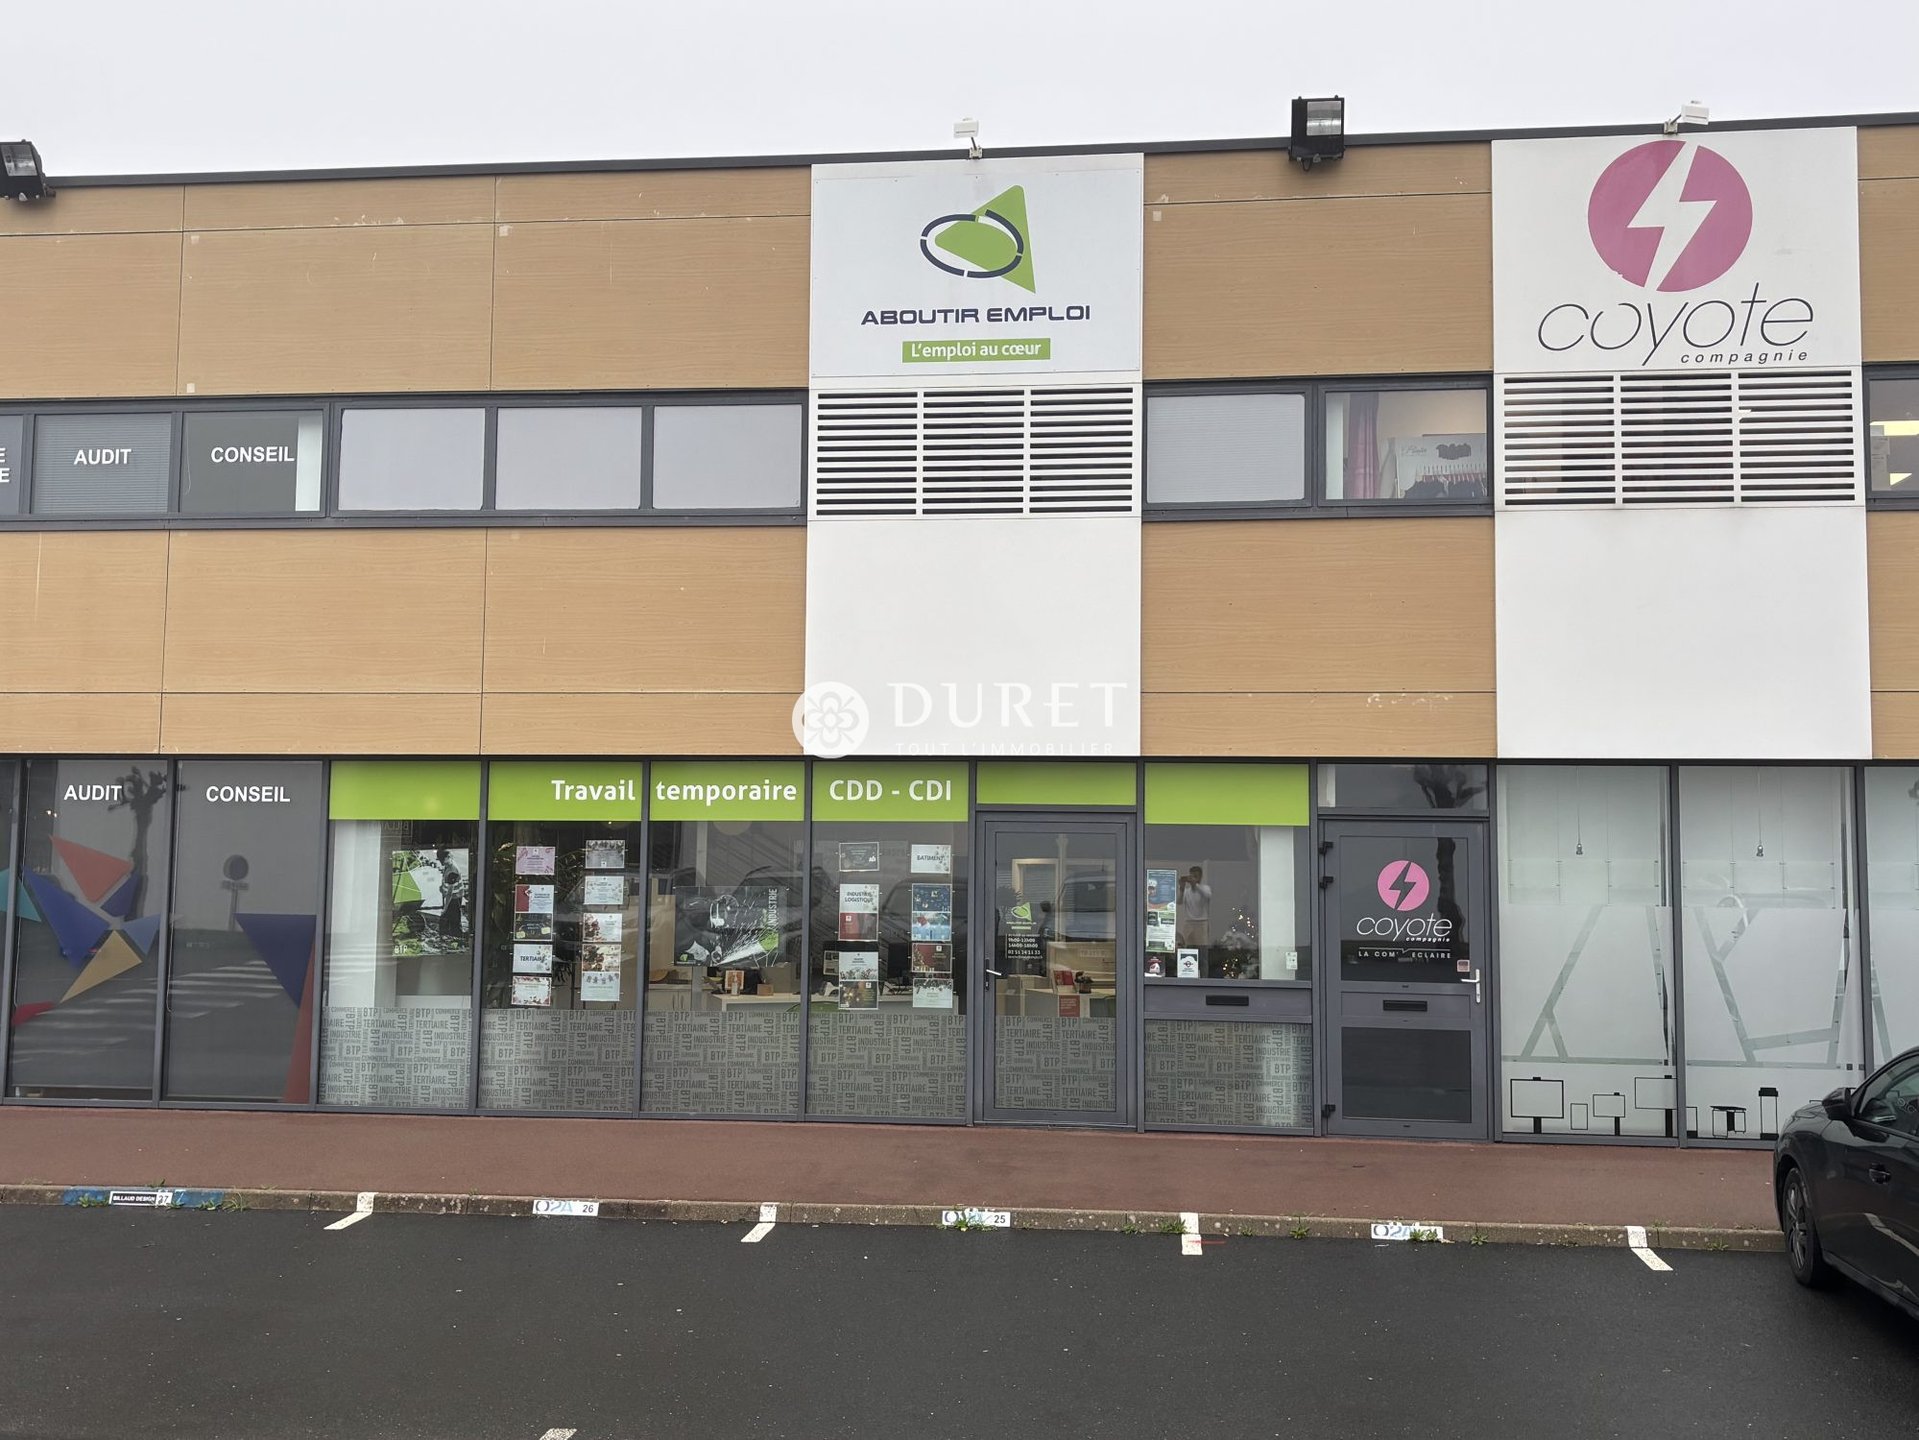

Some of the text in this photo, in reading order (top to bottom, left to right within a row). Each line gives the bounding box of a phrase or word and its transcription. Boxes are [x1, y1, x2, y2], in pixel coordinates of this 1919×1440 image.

[861, 305, 1090, 326] ABOUTIR EMPLOI
[1538, 282, 1814, 366] coyote
[910, 341, 976, 360] L'emploi
[980, 344, 998, 356] au
[1680, 350, 1809, 365] compagnie
[73, 448, 132, 465] AUDIT
[210, 446, 295, 463] CONSEIL
[63, 784, 122, 801] AUDIT
[205, 785, 290, 803] CONSEIL
[551, 779, 797, 806] Travail temporaire
[829, 779, 882, 801] CDD
[908, 779, 952, 801] CDI
[1356, 913, 1453, 942] coyote
[582, 1204, 594, 1213] 26
[994, 1215, 1006, 1224] 25
